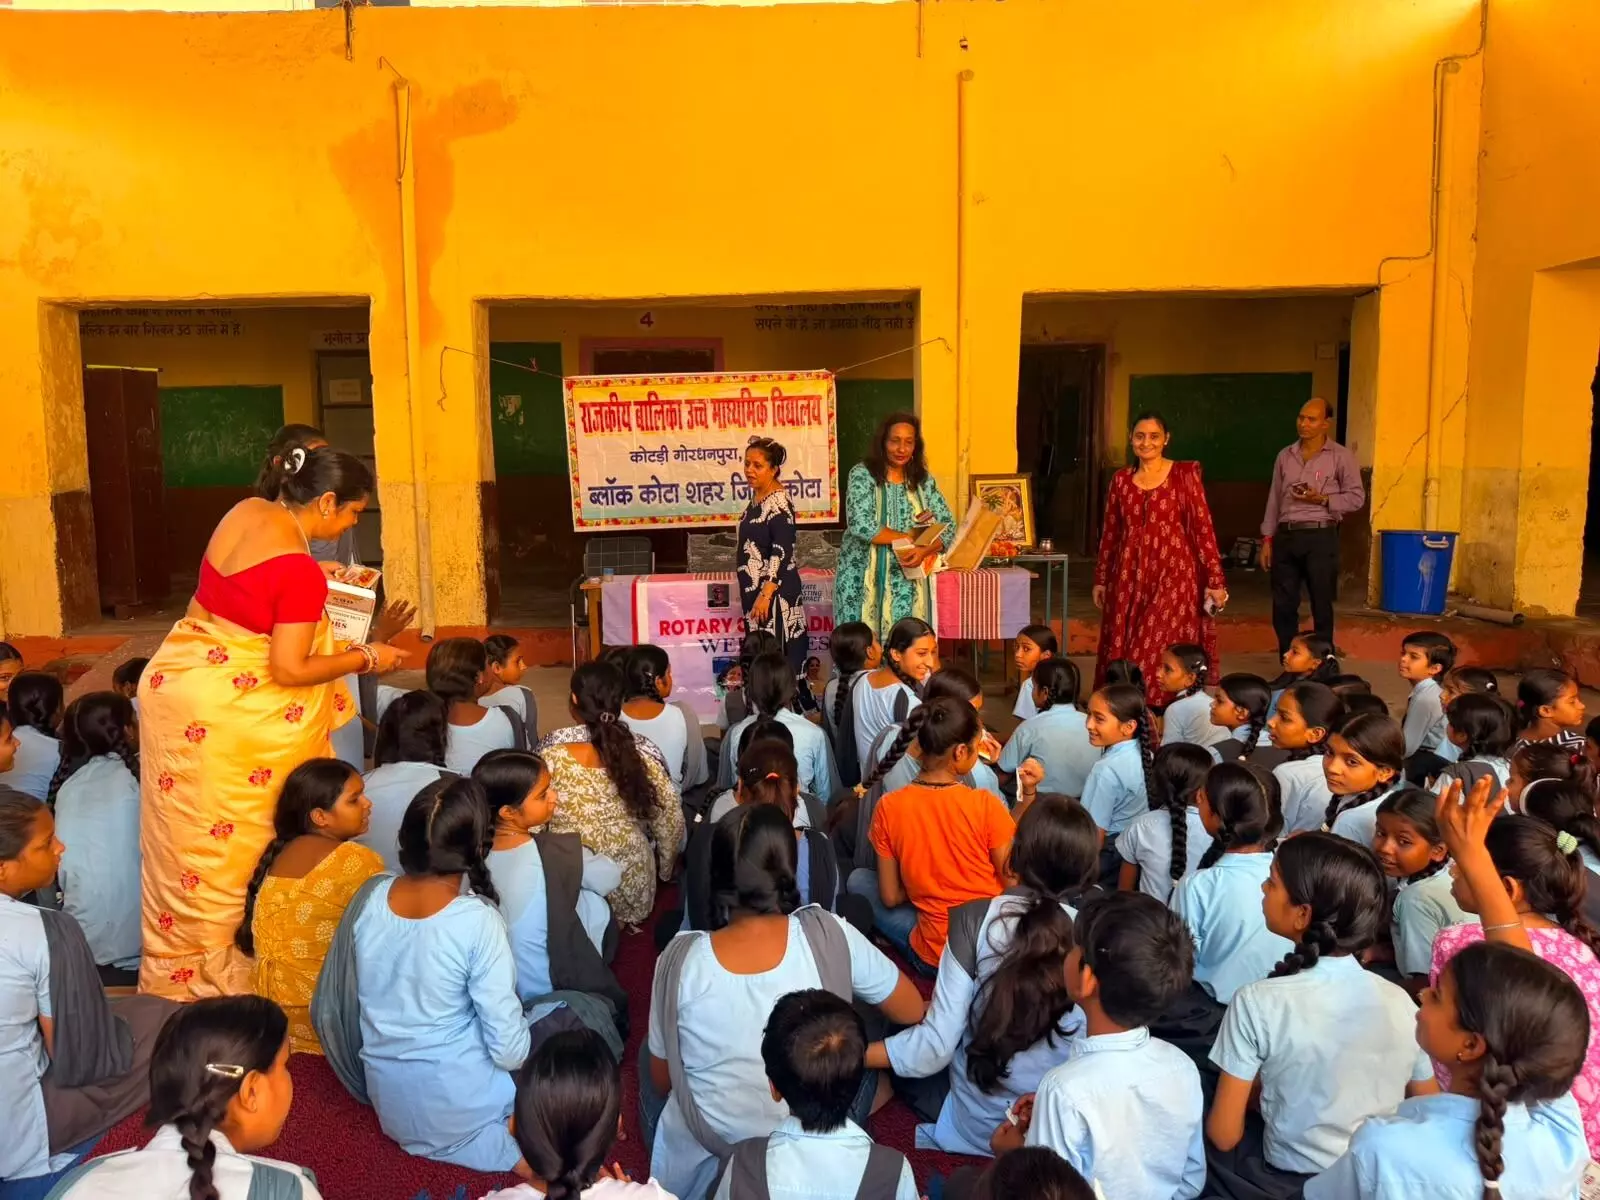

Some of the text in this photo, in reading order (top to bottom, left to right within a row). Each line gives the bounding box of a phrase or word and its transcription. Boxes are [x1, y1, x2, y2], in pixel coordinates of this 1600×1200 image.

[640, 311, 654, 327] 4
[323, 329, 369, 346] भूगोल प्र
[579, 386, 821, 433] राजकीय बालिका उच्च माध्यमिक विद्यालय
[630, 444, 743, 466] कोटड़ी गोरधनपुरा,
[588, 476, 633, 506] ब्लॉक
[638, 474, 680, 505] कोटा
[686, 481, 725, 506] शहर
[780, 469, 822, 500] कोटा
[659, 617, 732, 637] ROTARY
